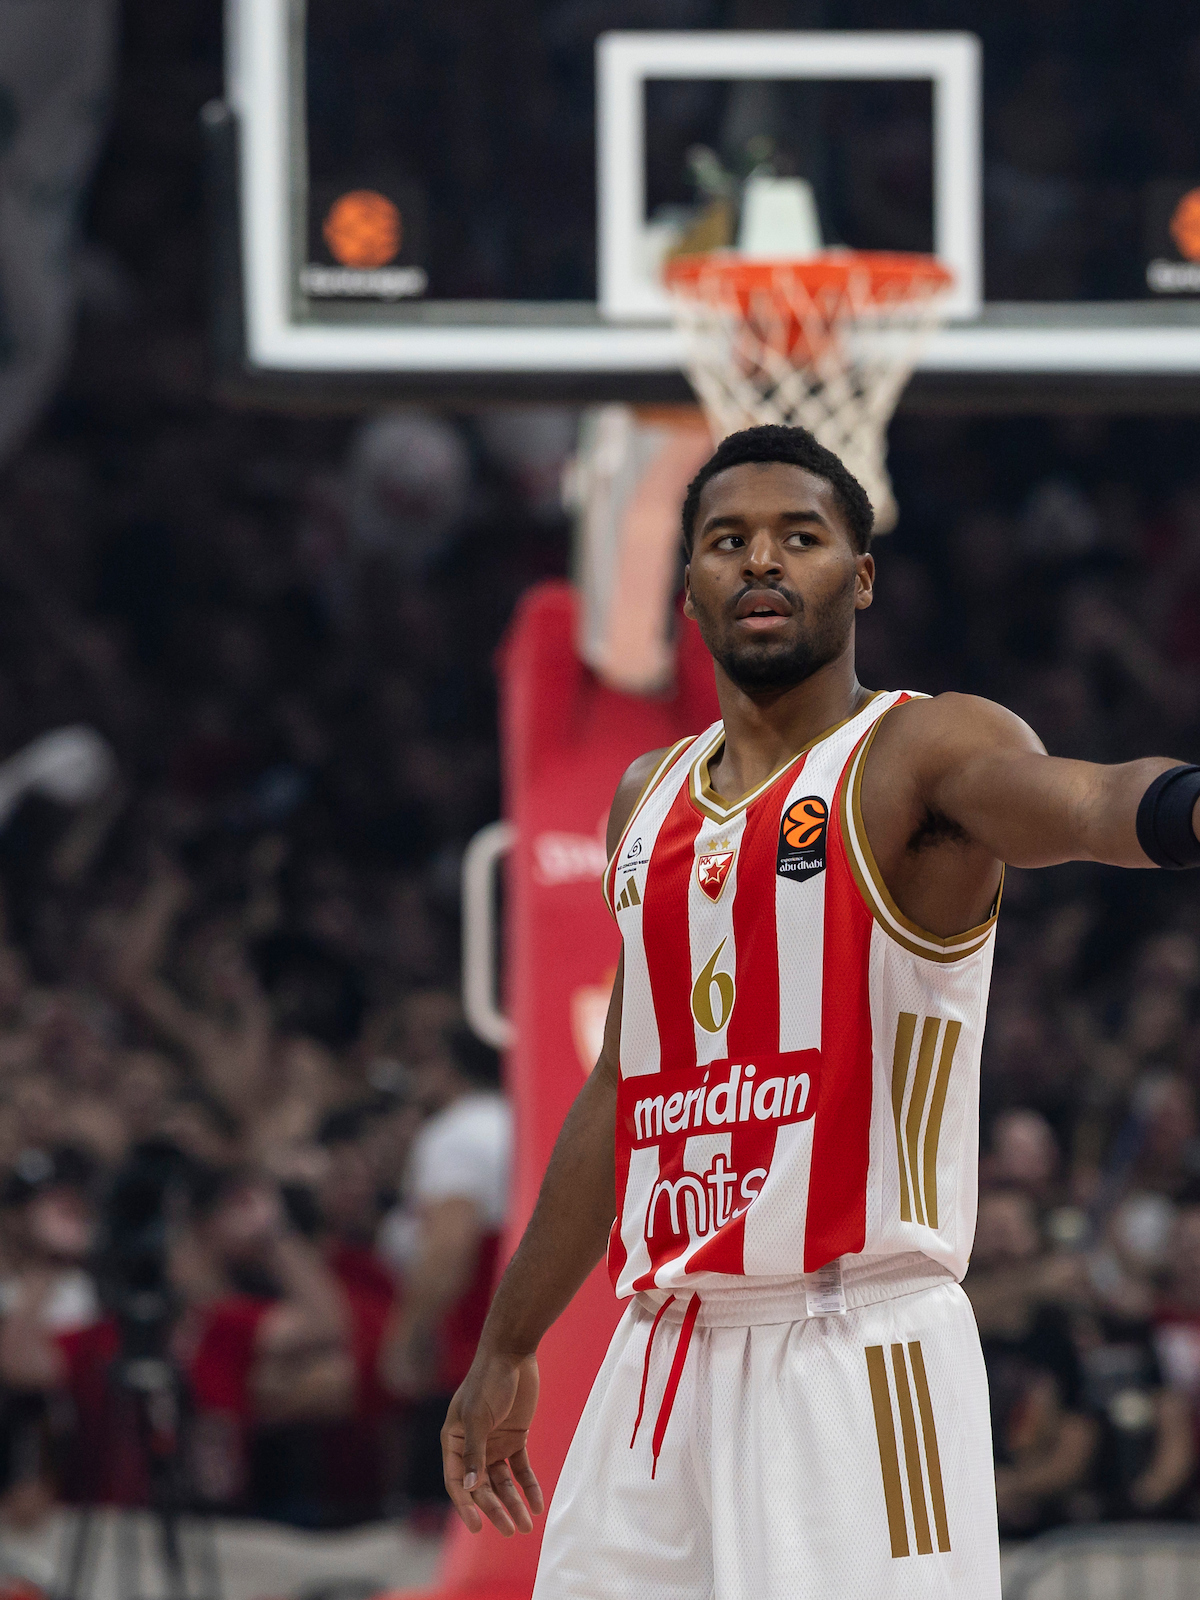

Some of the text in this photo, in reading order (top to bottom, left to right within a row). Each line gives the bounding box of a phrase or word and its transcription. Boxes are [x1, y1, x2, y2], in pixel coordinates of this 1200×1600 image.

[779, 858, 823, 872] abu dhabi
[690, 934, 736, 1034] 6
[633, 1064, 811, 1141] meridian
[647, 1158, 768, 1239] mts
